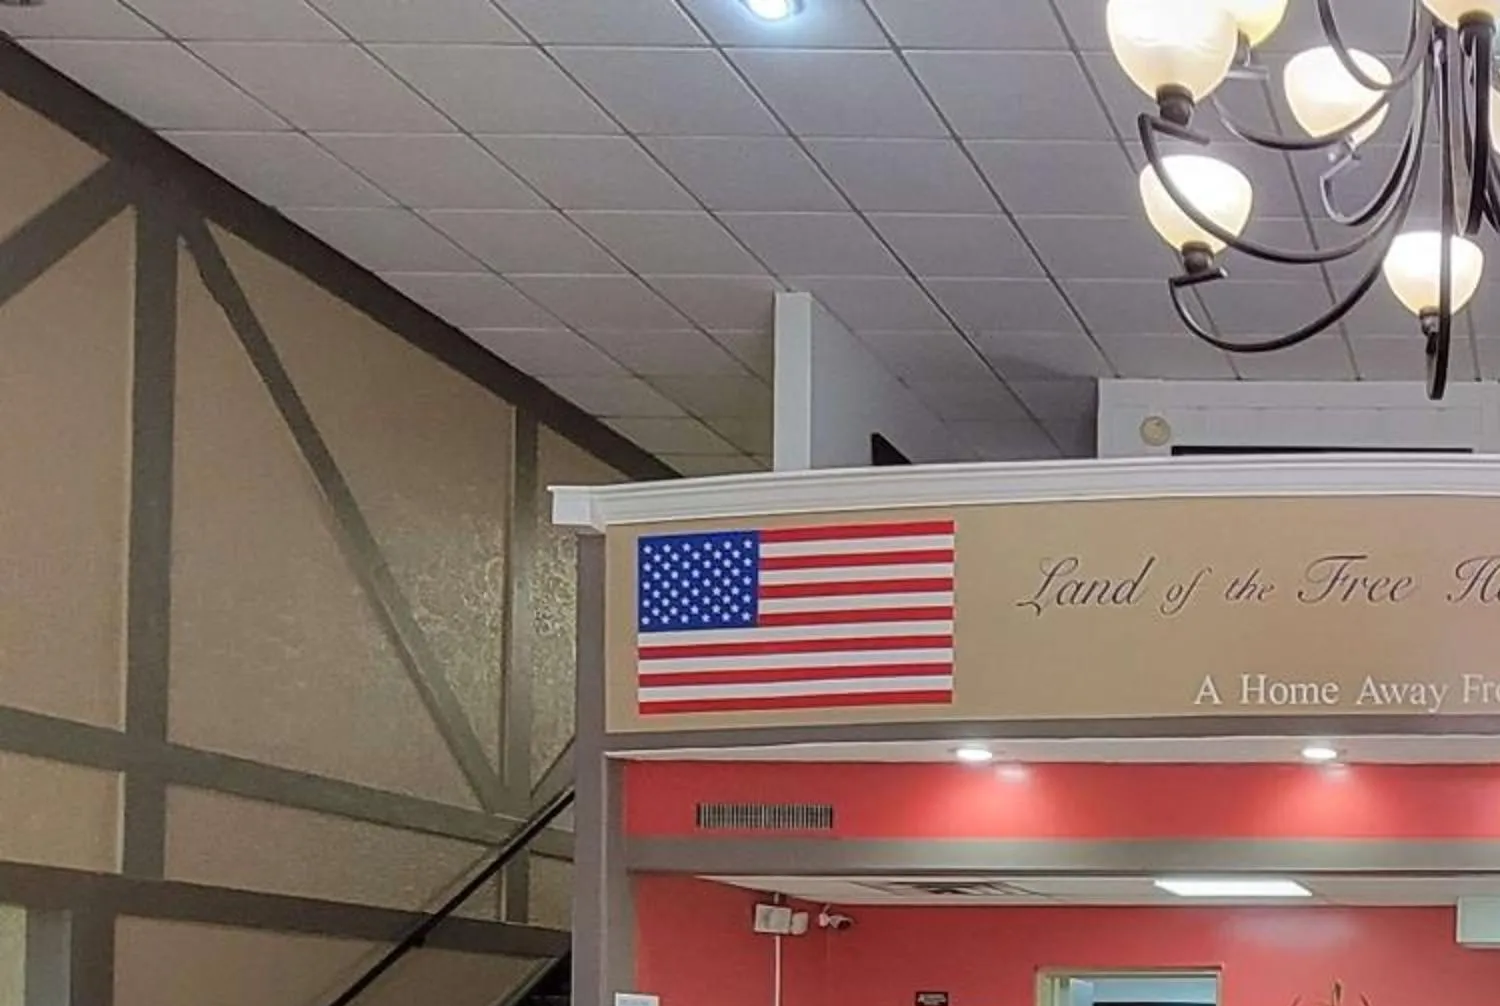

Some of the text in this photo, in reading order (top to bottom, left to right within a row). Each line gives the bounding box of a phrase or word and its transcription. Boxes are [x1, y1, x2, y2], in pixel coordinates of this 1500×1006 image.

[1015, 555, 1156, 617] Land
[1158, 567, 1213, 617] of
[1224, 568, 1277, 602] the
[1297, 554, 1413, 604] Free
[1193, 675, 1221, 705] A
[1240, 674, 1340, 705] Home
[1356, 674, 1449, 713] Away
